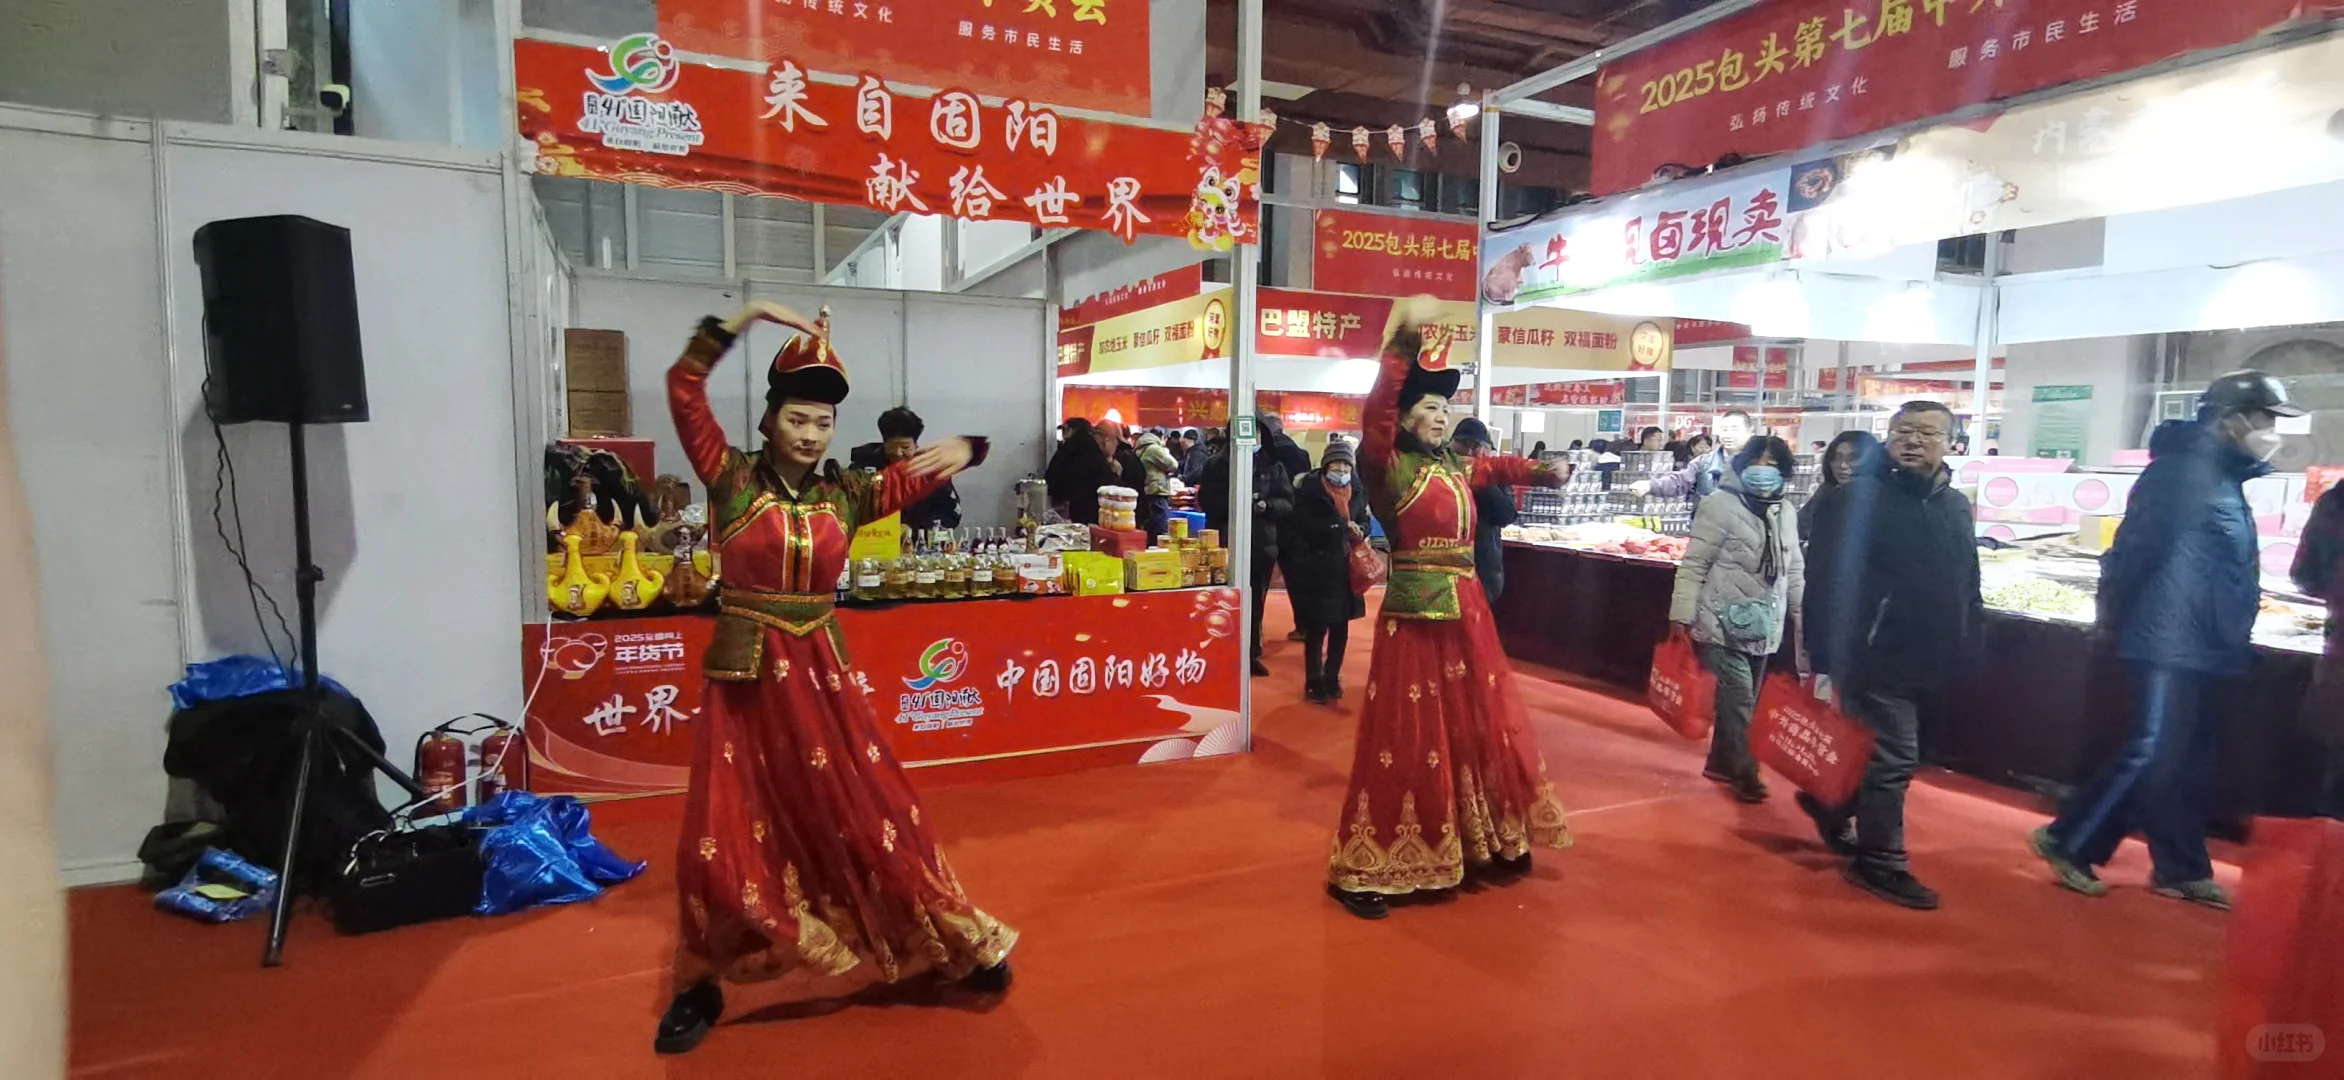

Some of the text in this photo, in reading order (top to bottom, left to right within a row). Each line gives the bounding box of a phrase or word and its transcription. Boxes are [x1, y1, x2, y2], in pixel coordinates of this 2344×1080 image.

[957, 20, 1084, 55] 服务市民生活
[1640, 0, 1984, 115] 2025包头第七届中
[1948, 1, 2138, 69] 服务市民生活
[760, 60, 1057, 156] 来自固阳
[1729, 76, 1869, 132] 弘扬传统文化
[866, 153, 1151, 240] 献给世界
[1260, 307, 1362, 341] 巴盟特产
[1564, 330, 1618, 350] 双福面粉
[615, 643, 684, 663] 年货节
[997, 648, 1207, 704] 中国固阳好物
[582, 685, 699, 737] 世界
